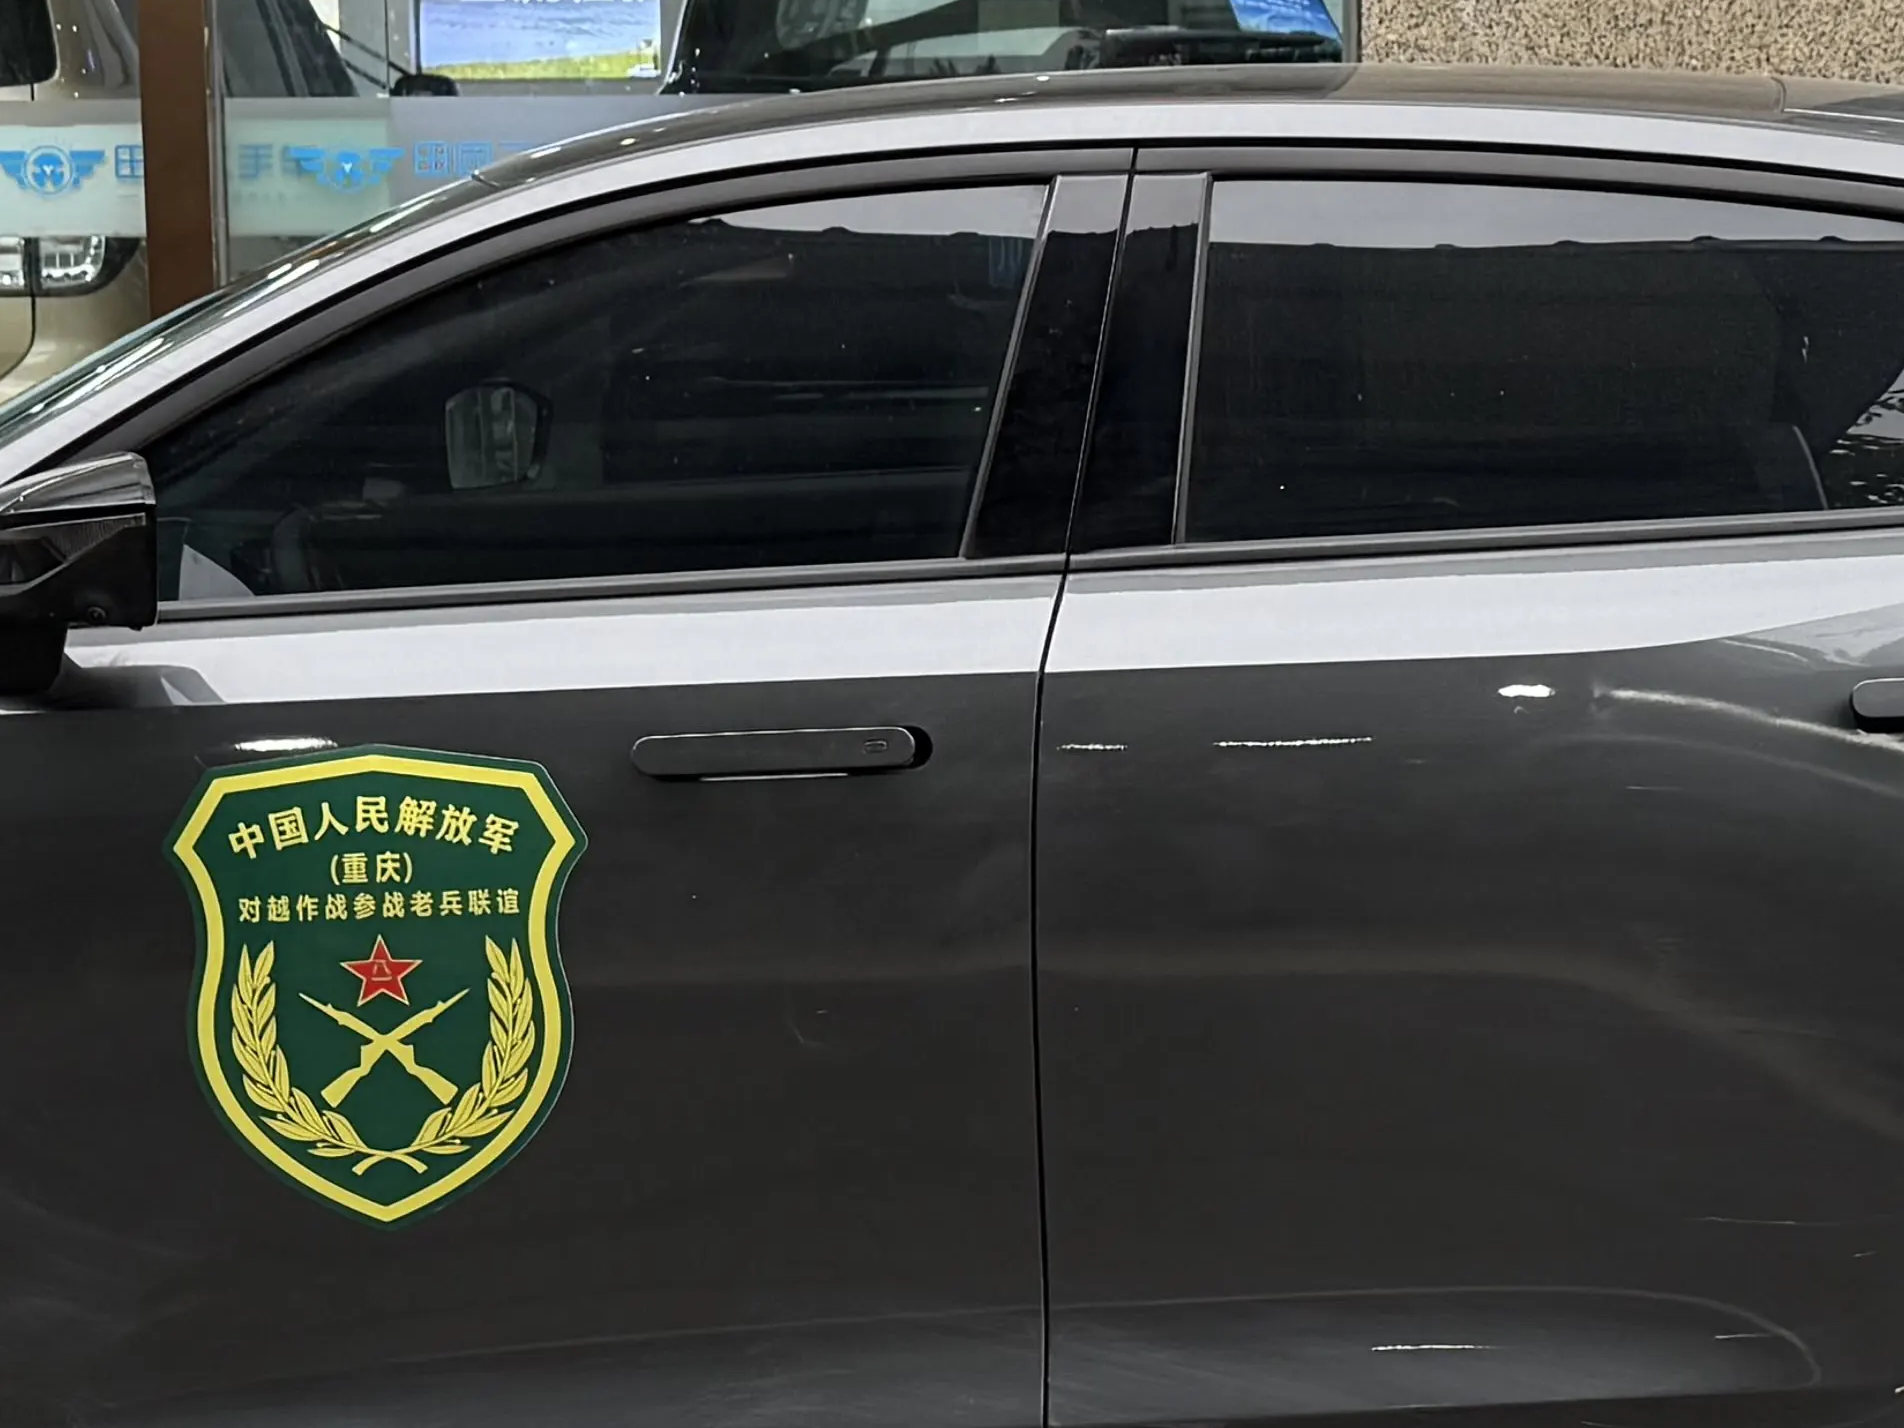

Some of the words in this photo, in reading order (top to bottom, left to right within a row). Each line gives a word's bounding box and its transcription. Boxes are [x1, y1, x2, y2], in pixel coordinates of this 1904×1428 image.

[228, 795, 520, 859] 中国人民解放军
[330, 851, 413, 886] (重庆)
[238, 888, 520, 923] 对越作战参战老兵联谊
